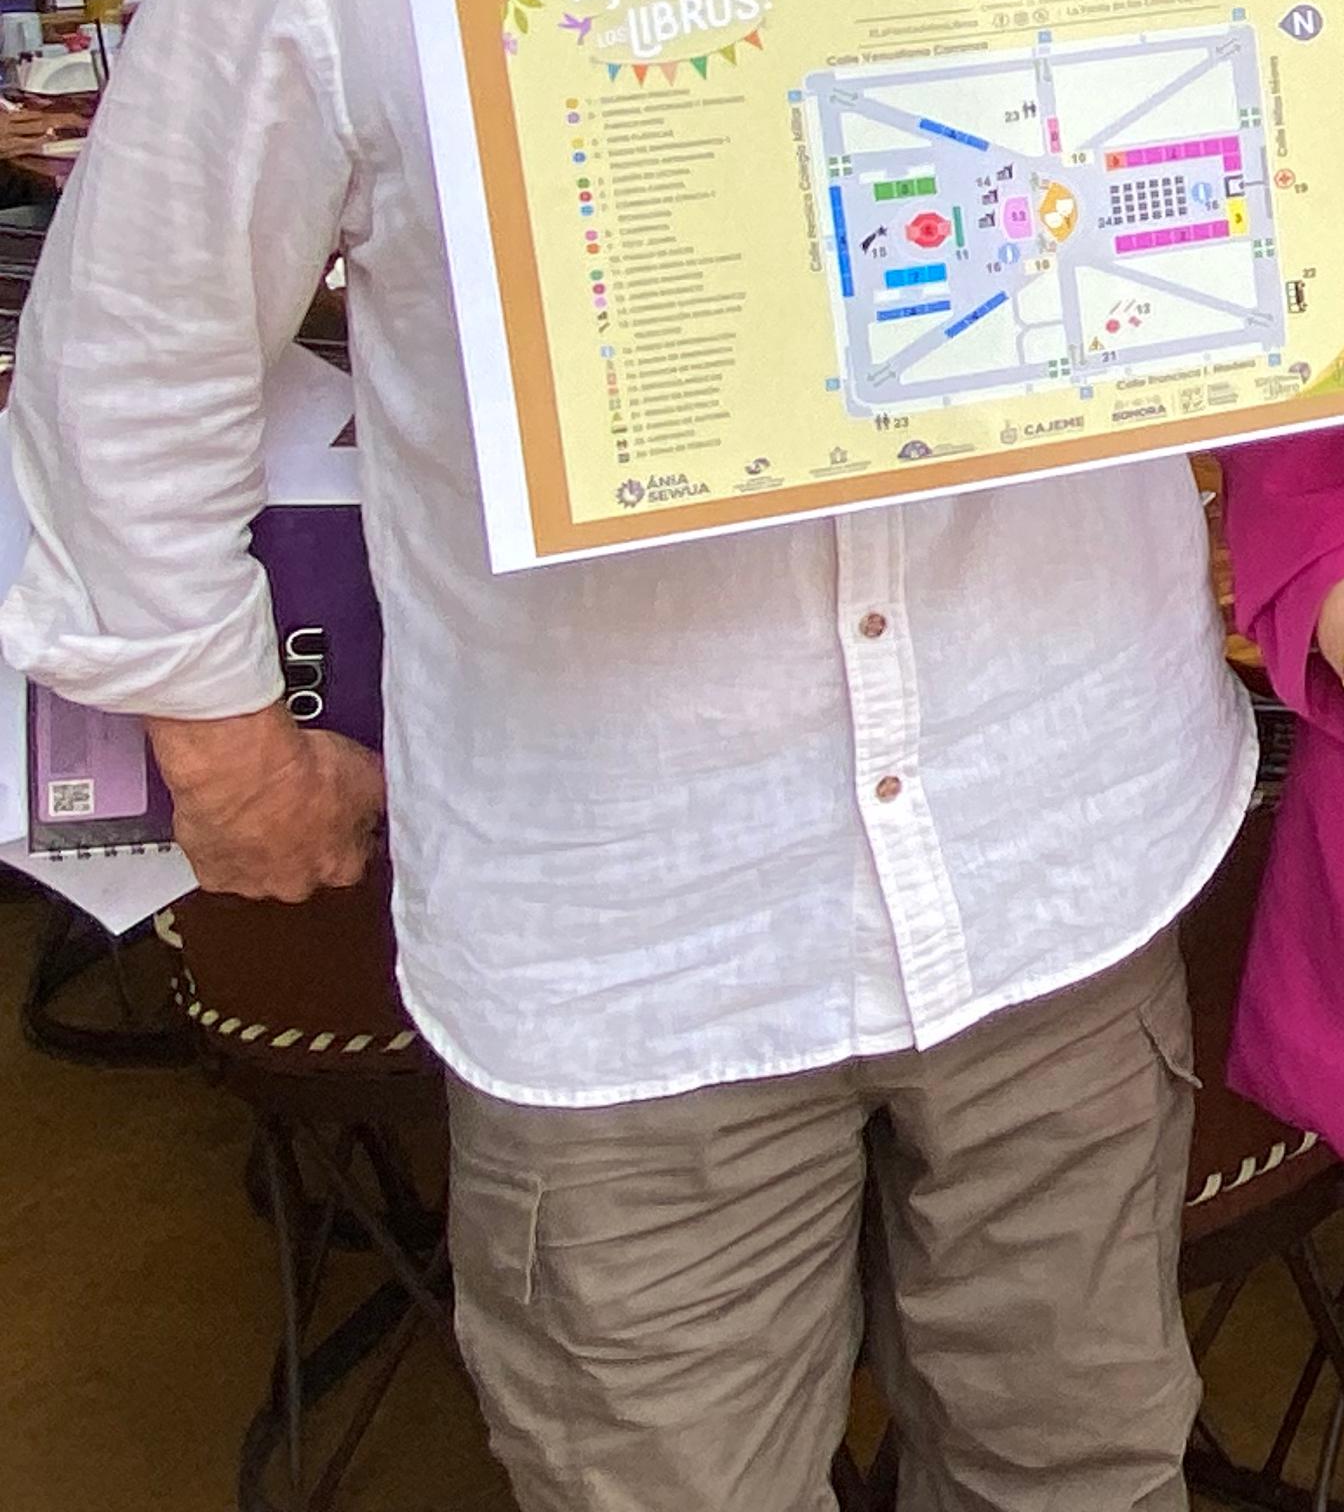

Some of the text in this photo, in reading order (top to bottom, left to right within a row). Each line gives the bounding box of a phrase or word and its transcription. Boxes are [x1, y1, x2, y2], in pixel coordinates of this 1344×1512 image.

[1292, 9, 1315, 36] N
[596, 24, 629, 49] LOS
[1023, 415, 1085, 436] CAJEME
